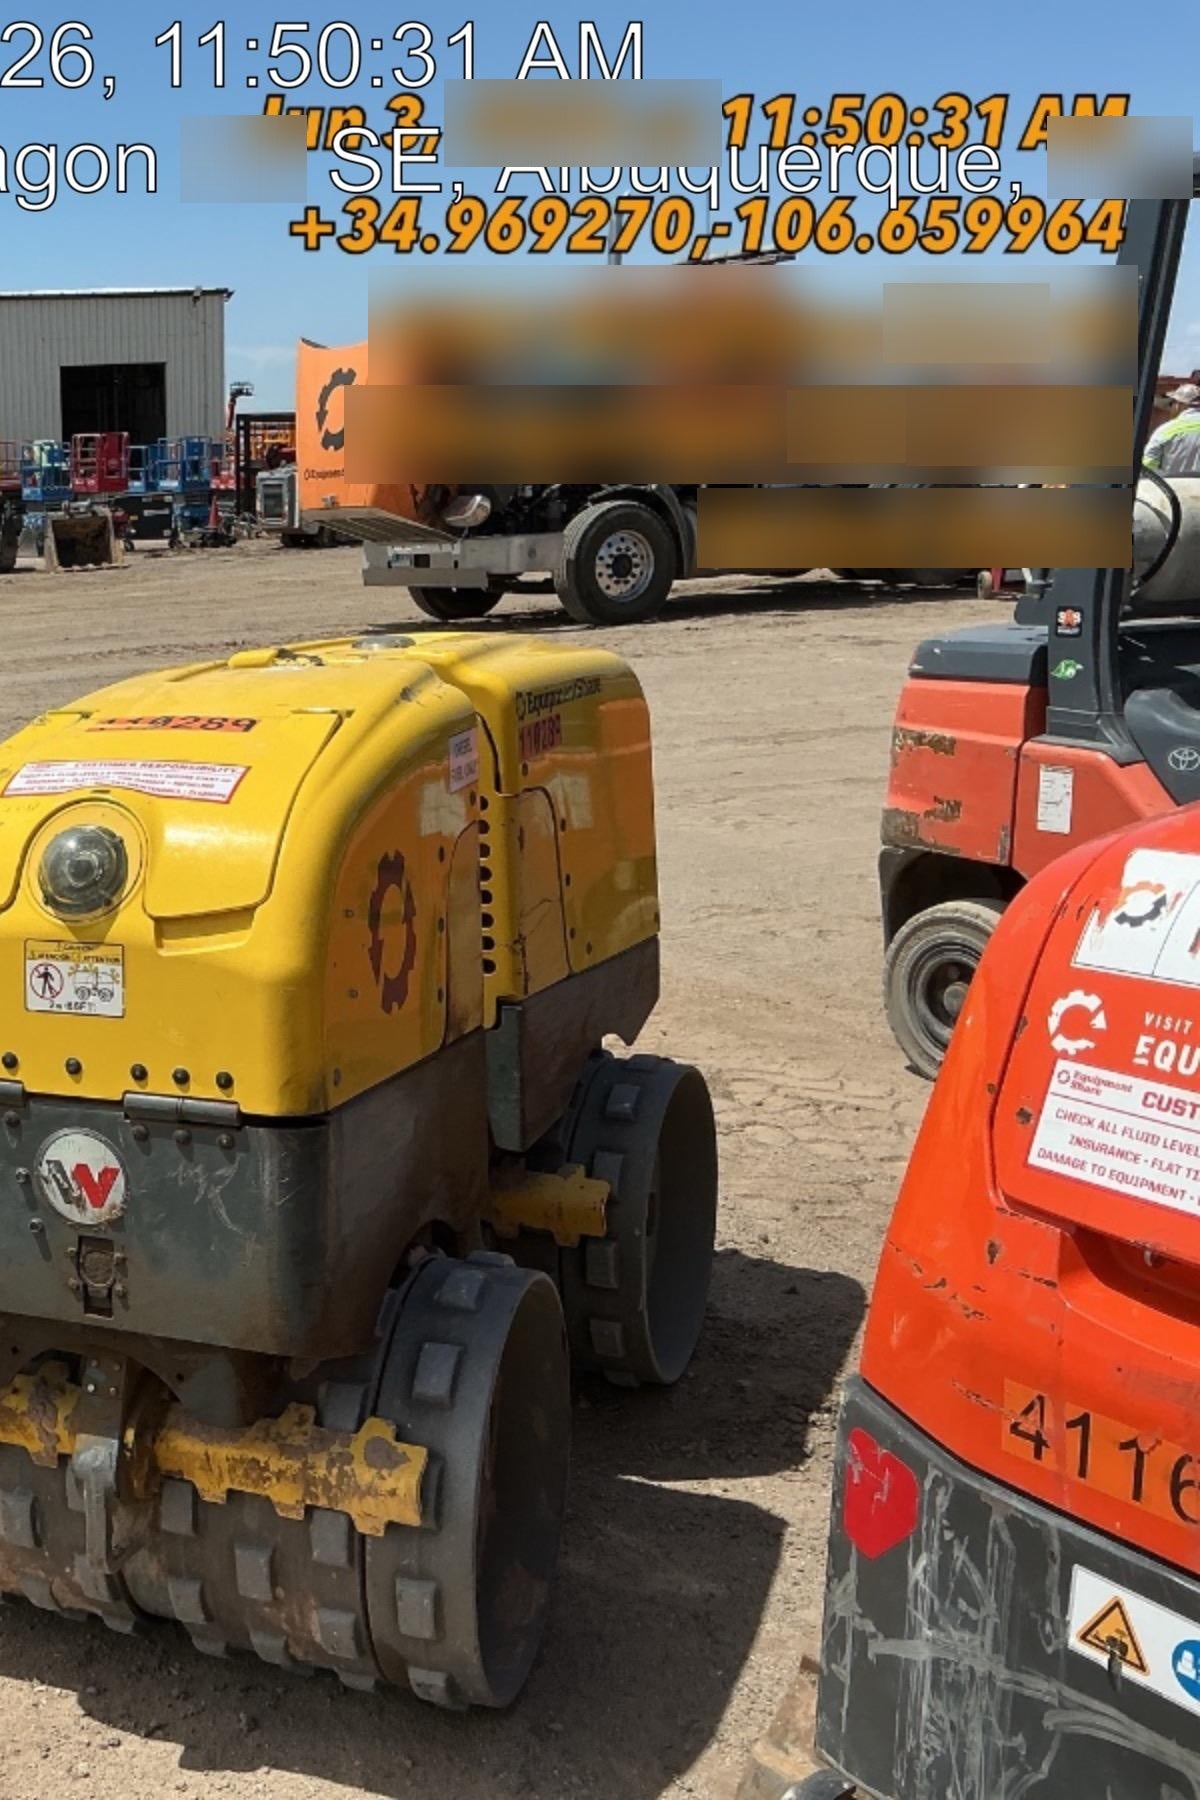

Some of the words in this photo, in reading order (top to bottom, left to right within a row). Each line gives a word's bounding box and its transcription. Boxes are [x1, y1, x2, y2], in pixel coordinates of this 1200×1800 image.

[1144, 1011, 1193, 1035] VISIT
[1069, 1079, 1102, 1097] Share
[1072, 1070, 1133, 1093] Equipment
[1055, 1107, 1096, 1128] CHECK
[1097, 1119, 1118, 1136] ALL
[1121, 1125, 1161, 1147] FLUID
[1068, 1133, 1143, 1165] INSURANCE
[1150, 1157, 1182, 1178] FLAT
[1037, 1147, 1089, 1172] DAMAGE
[1090, 1163, 1107, 1178] TO
[1108, 1168, 1187, 1202] EQUIPMENT
